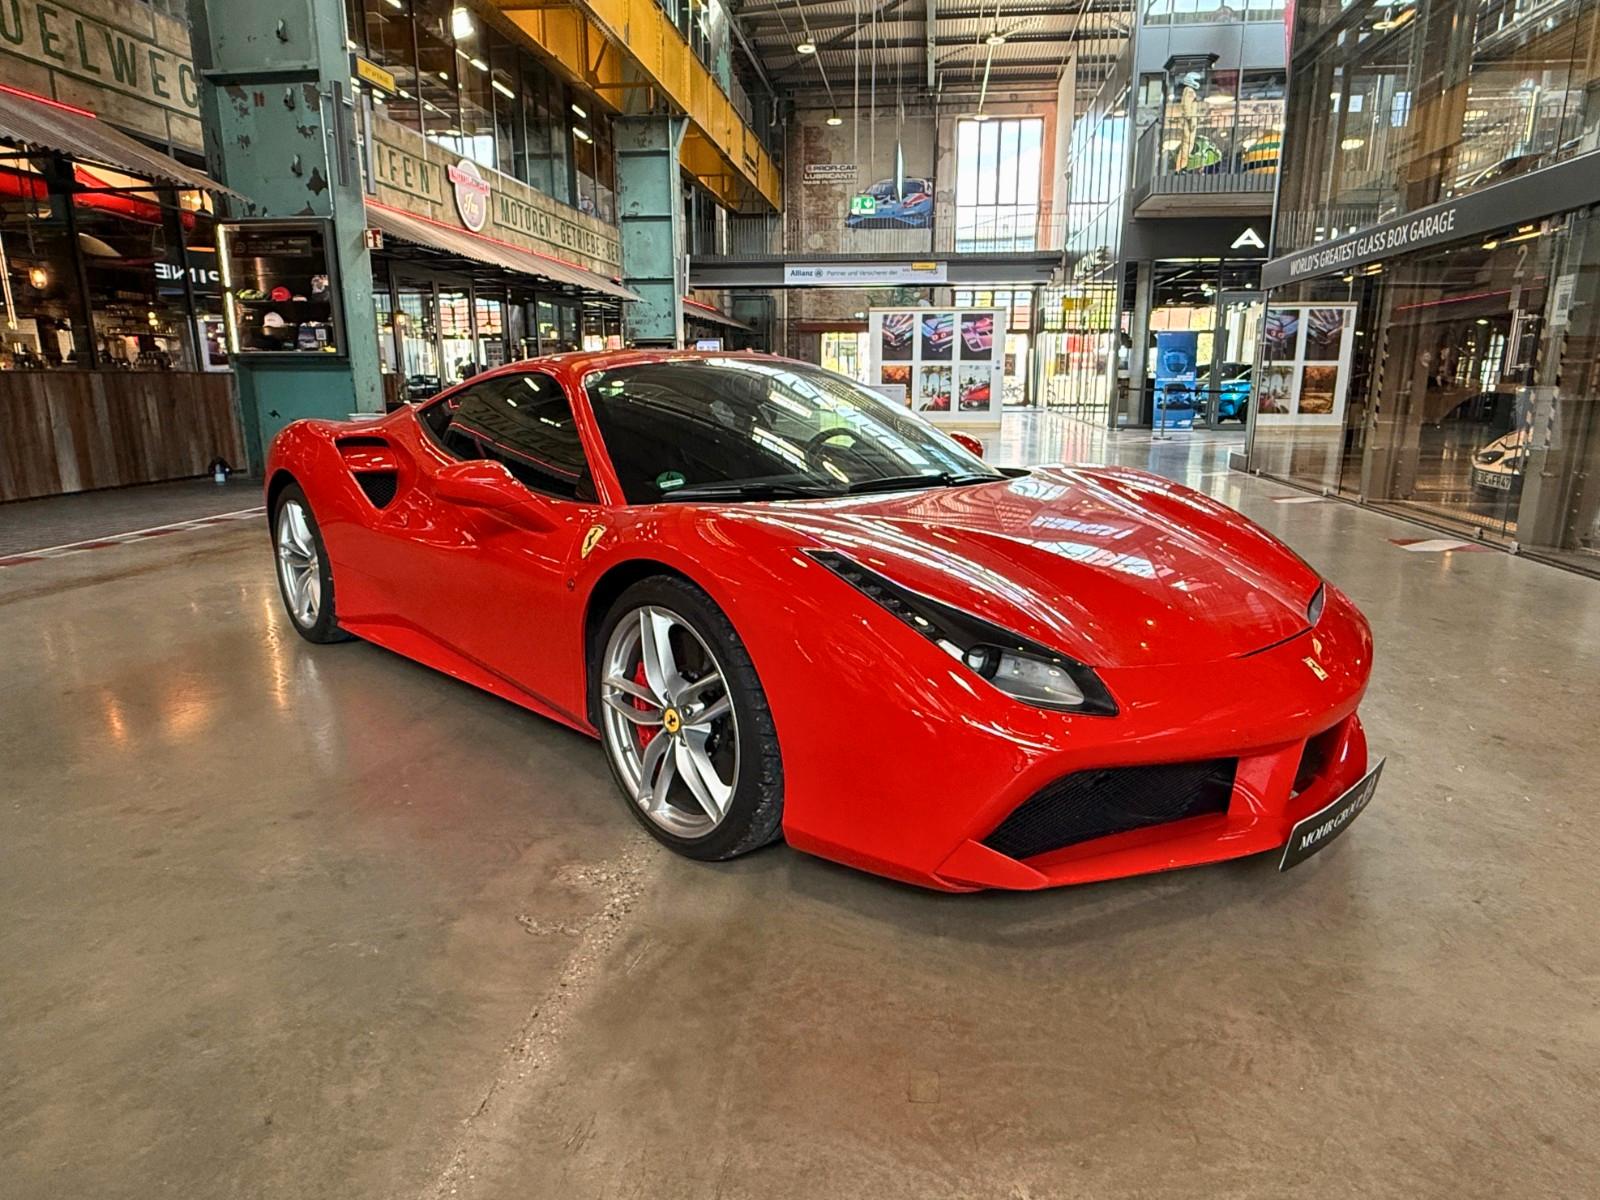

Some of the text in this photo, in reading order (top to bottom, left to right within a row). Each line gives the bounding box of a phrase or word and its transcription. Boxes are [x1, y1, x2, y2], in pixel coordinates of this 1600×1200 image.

[500, 196, 552, 239] MOTOREN
[560, 222, 601, 256] GETRIEBE
[1289, 252, 1319, 277] WORLD'S
[1319, 240, 1358, 267] GREATEST
[1357, 231, 1387, 257] GLASS
[1387, 224, 1409, 249] BOX
[1409, 208, 1456, 242] GARAGE
[790, 269, 813, 277] Allianz
